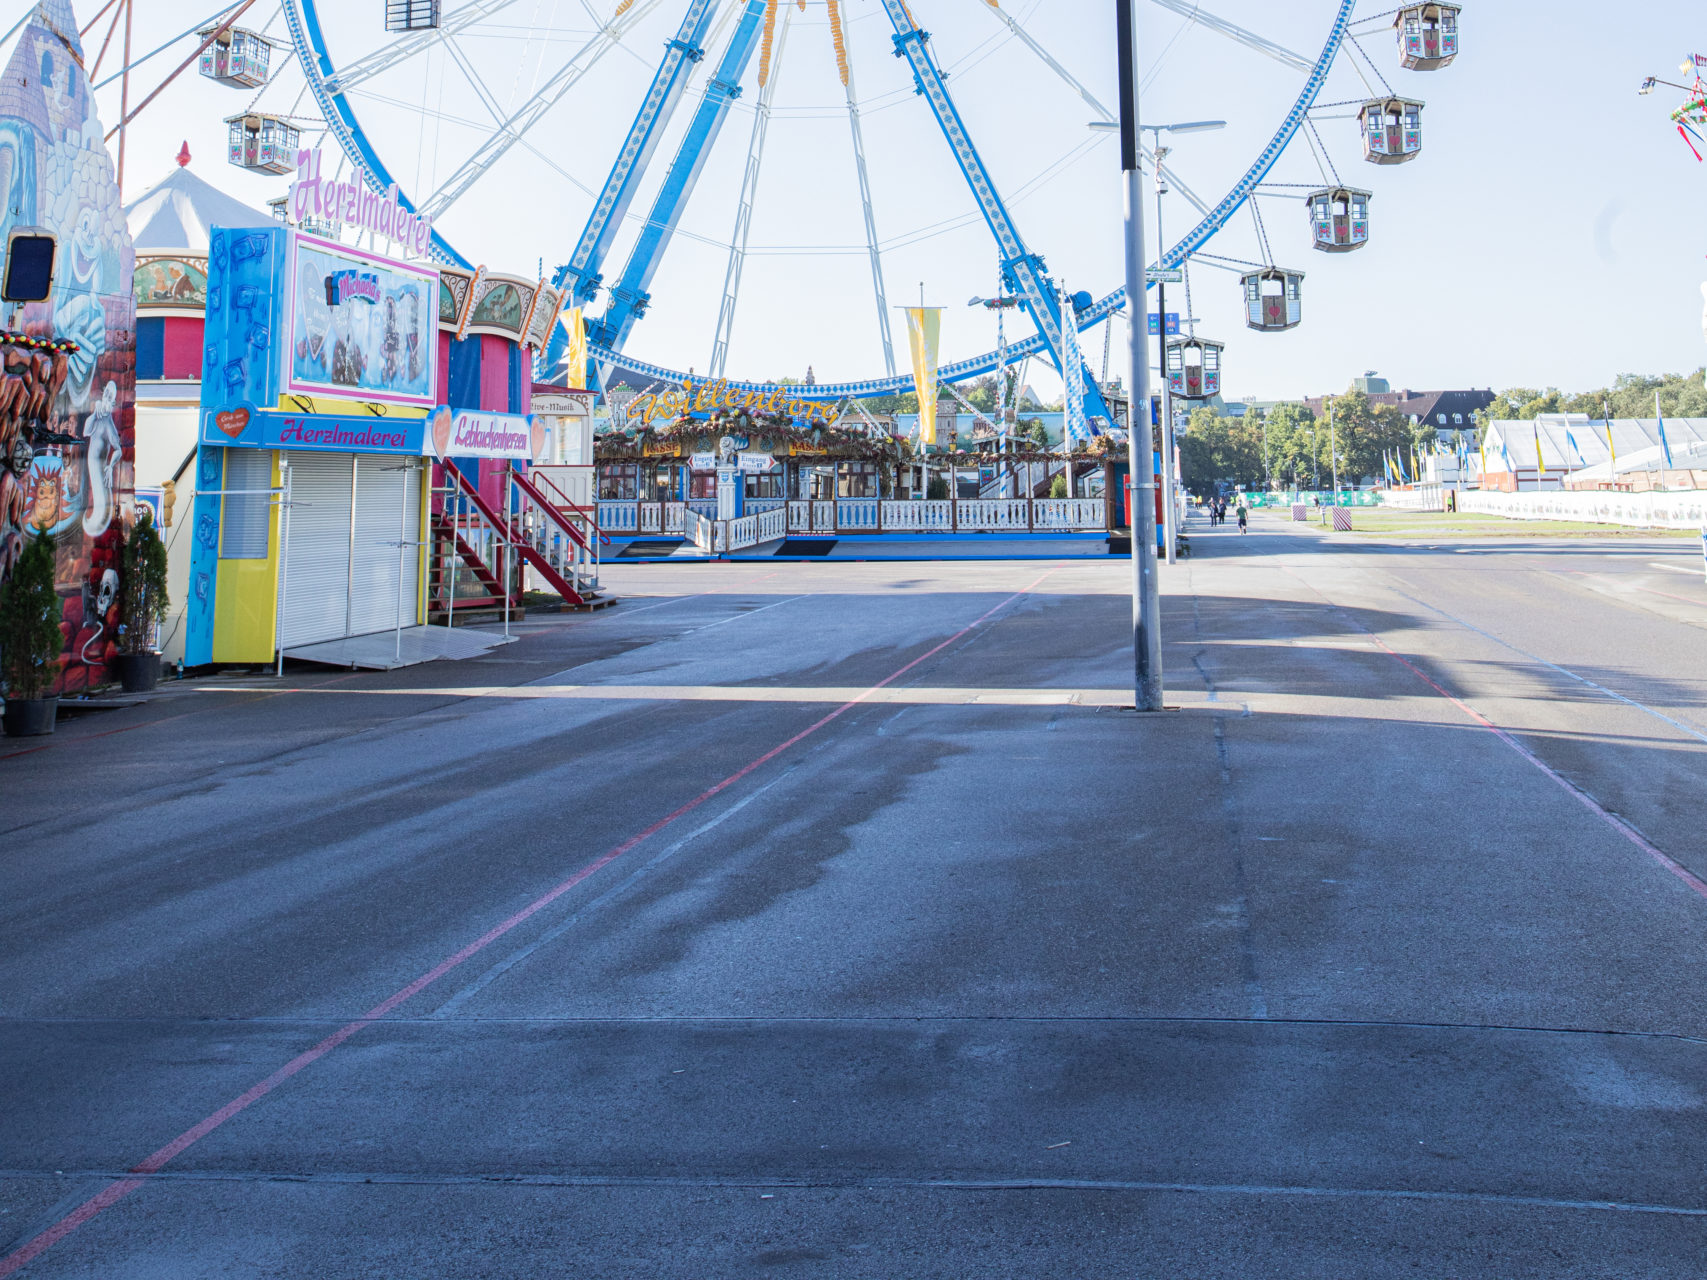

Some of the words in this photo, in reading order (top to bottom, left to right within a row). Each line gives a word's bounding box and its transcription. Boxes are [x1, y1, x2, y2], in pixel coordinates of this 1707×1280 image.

[295, 148, 433, 260] Herzlmalerei
[626, 377, 839, 426] Willenborg
[279, 419, 408, 448] Herzlmalerei
[454, 415, 528, 451] Lebkuchenherzen
[741, 455, 767, 465] Eingang
